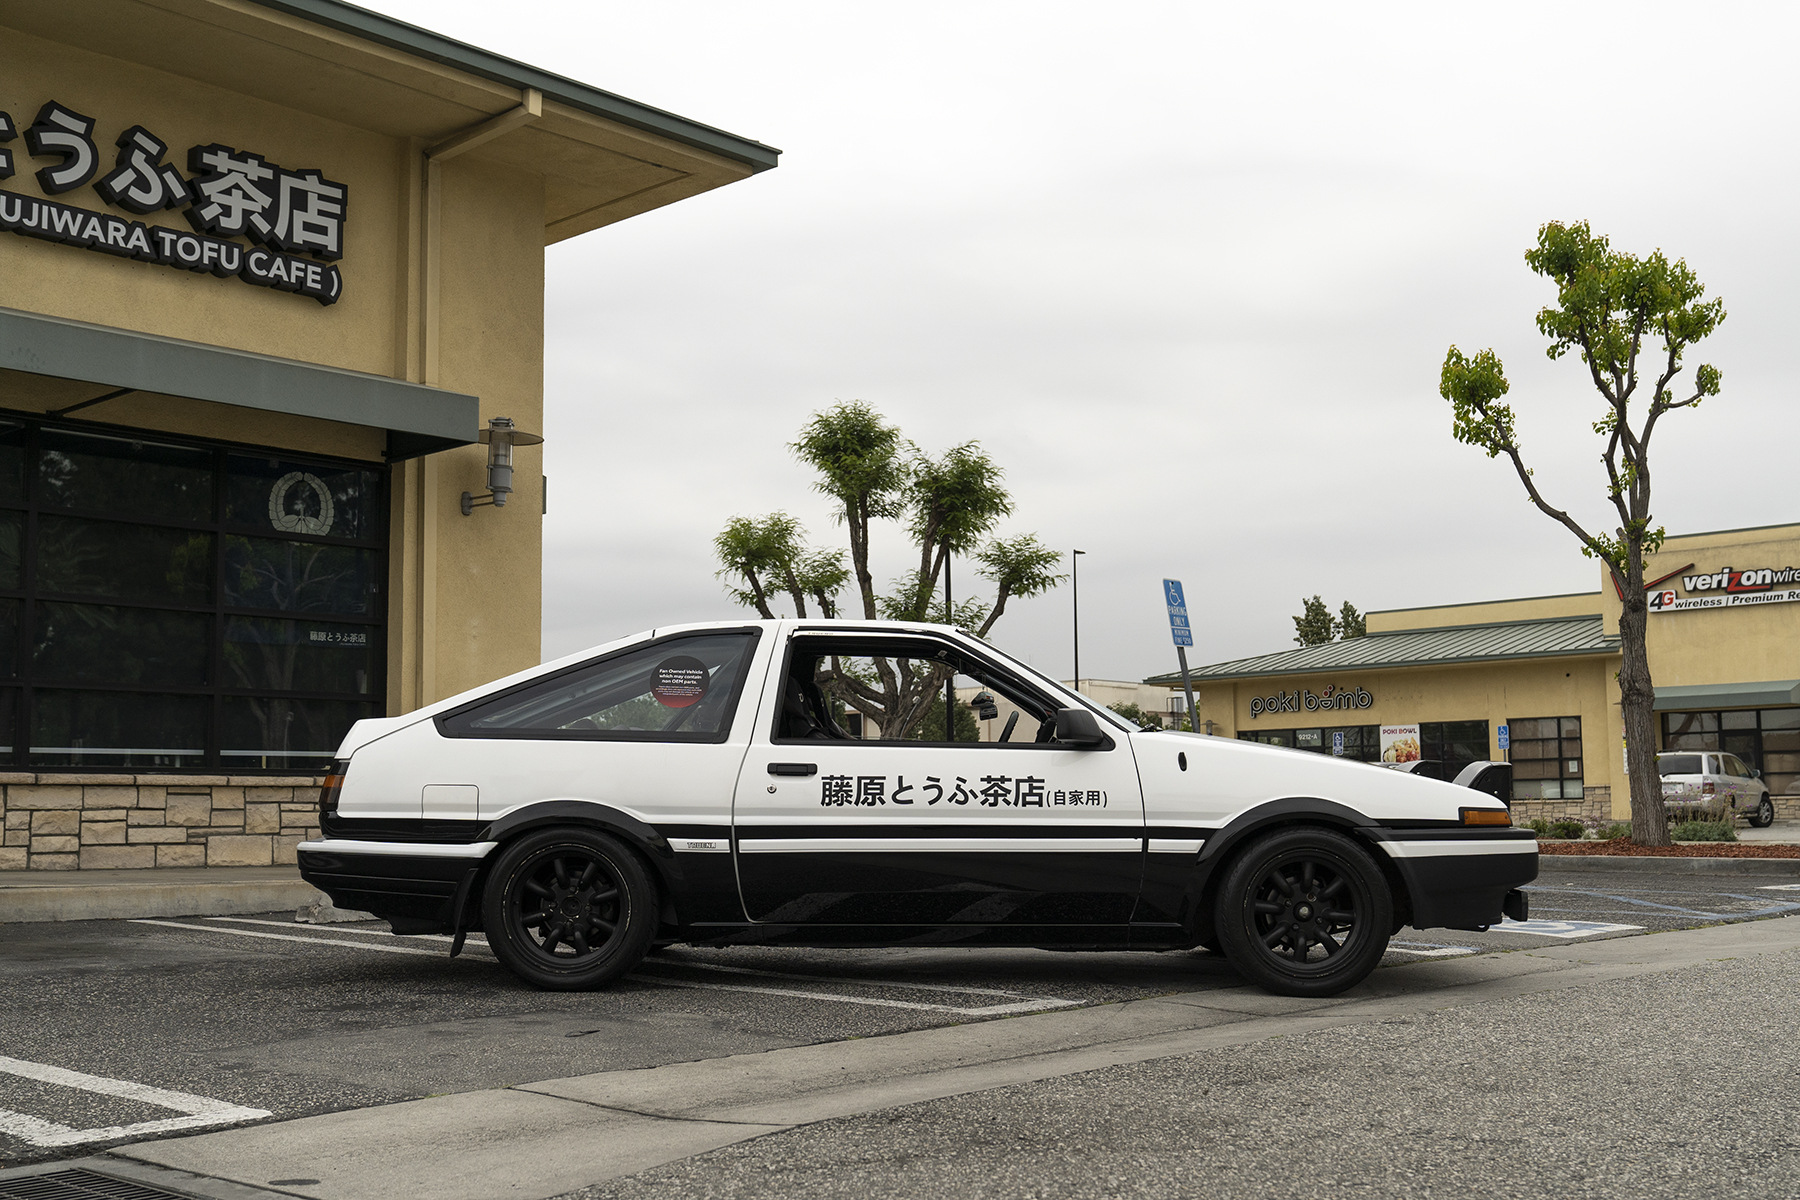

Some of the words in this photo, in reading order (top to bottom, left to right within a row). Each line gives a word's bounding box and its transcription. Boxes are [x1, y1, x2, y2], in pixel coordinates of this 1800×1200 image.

[0, 108, 344, 253] うふ茶店
[158, 231, 240, 271] TOFU
[1168, 605, 1187, 616] PARKING
[1650, 591, 1674, 610] 4G
[1675, 598, 1723, 609] wireless
[1732, 593, 1784, 604] Premium
[1173, 616, 1186, 626] ONLY
[1250, 690, 1299, 718] poki
